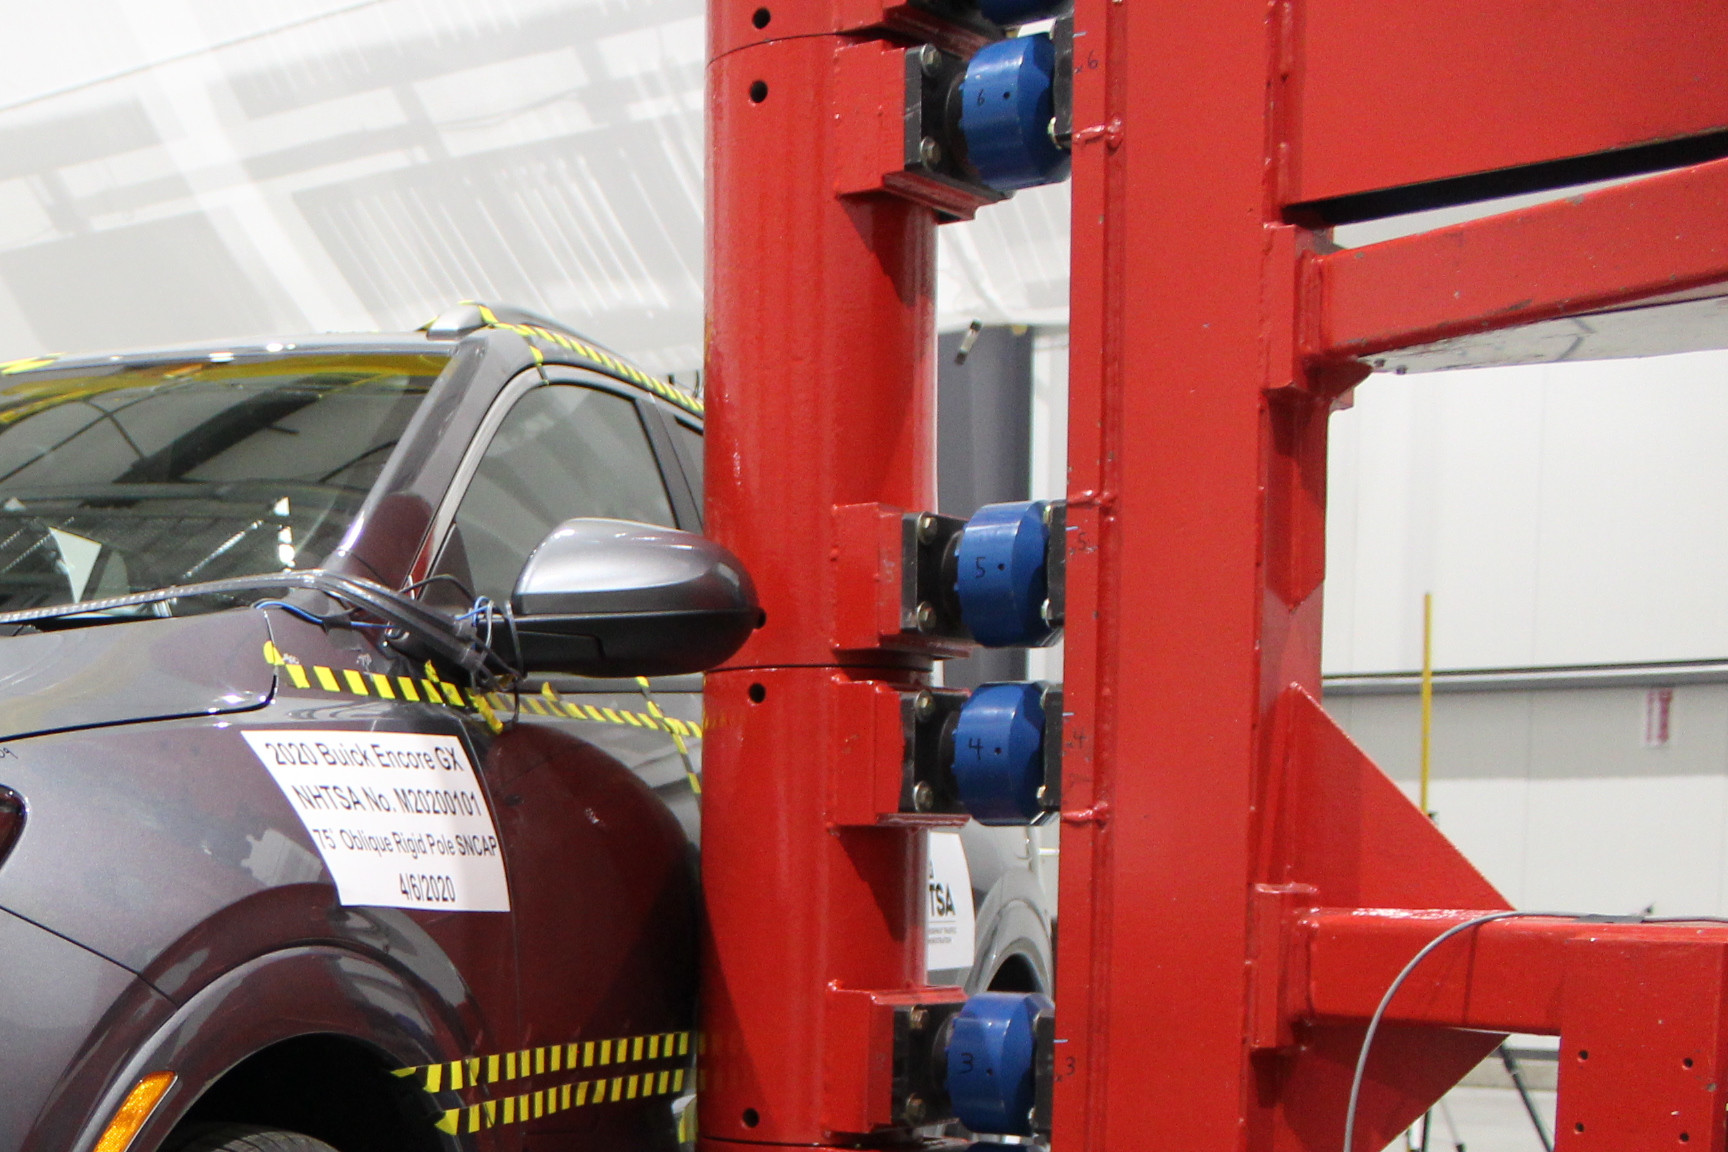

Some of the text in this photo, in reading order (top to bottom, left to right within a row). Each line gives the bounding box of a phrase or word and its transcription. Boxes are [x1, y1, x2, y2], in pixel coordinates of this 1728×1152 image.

[977, 88, 986, 107] 6
[975, 556, 987, 579] 5
[265, 743, 464, 771] 2020 Buick Encore GX
[968, 737, 984, 761] 4
[292, 786, 481, 816] NHTSA No. M20200101
[340, 829, 393, 857] Oblique
[392, 832, 427, 859] Rigid
[426, 834, 455, 855] Pole
[456, 835, 496, 856] SNCAP
[400, 874, 455, 902] 4/6/2020
[928, 882, 957, 917] TSA
[960, 1052, 975, 1075] 3
[1065, 1056, 1076, 1076] 3
